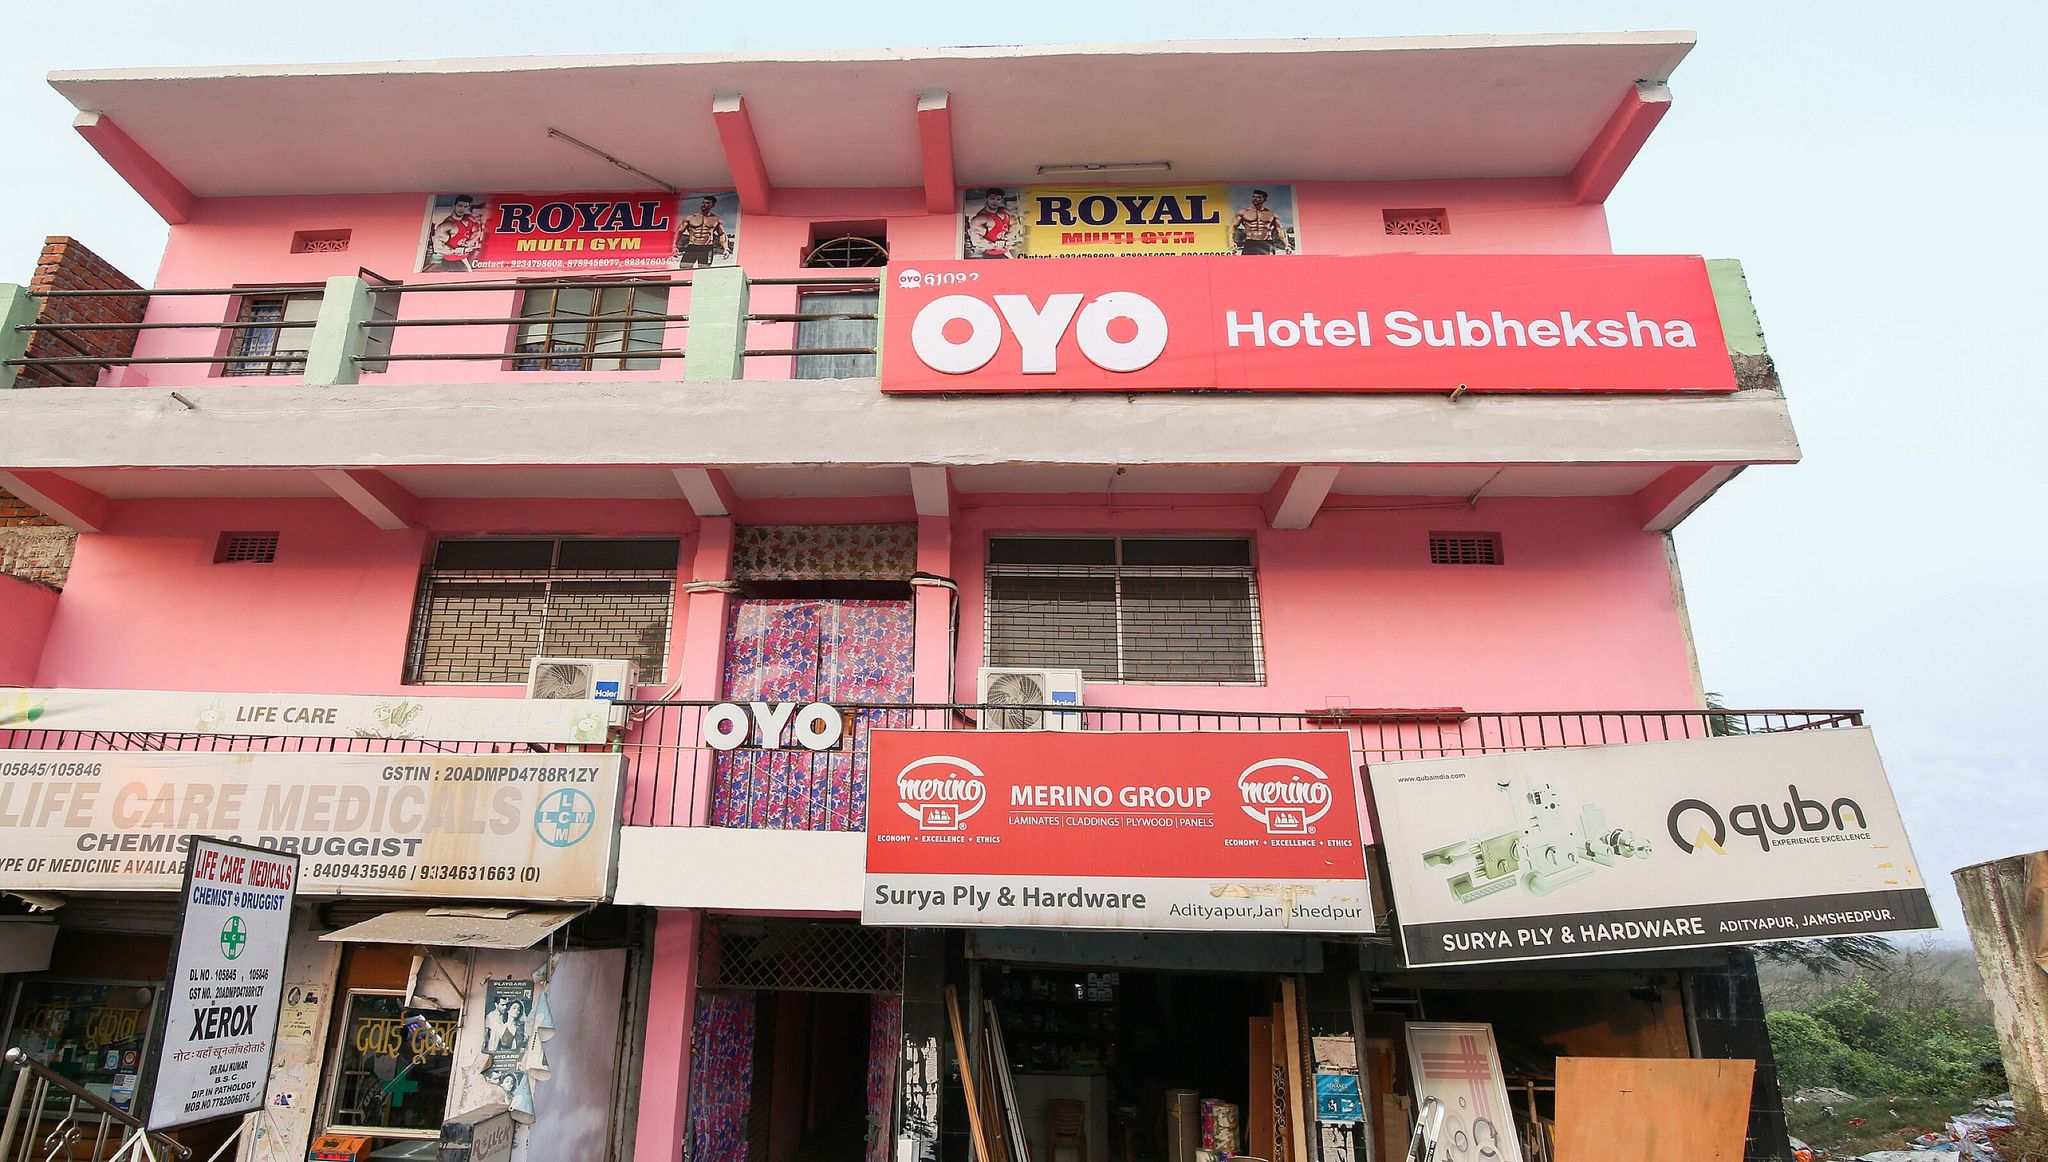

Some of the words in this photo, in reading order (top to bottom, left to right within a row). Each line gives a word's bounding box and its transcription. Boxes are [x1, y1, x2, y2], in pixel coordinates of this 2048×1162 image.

[495, 200, 669, 234] ROYAL
[1035, 195, 1221, 227] ROYAL
[516, 238, 584, 252] MULTI
[590, 237, 642, 251] GYM
[471, 259, 504, 269] Contact
[624, 257, 677, 267] 923476056
[911, 290, 1169, 375] OYO
[1226, 308, 1369, 348] Hotel
[1384, 308, 1697, 351] Subheksha
[595, 689, 618, 698] Haier
[236, 705, 279, 723] LIFE
[282, 706, 338, 724] CARE
[702, 702, 843, 750] OYO
[382, 766, 431, 781] GSTIN
[444, 766, 600, 783] 20ADMPD4788R1ZY
[1397, 772, 1466, 783] www.qubaindia.com
[899, 773, 981, 801] merino
[1010, 785, 1114, 807] MERINO
[1118, 786, 1211, 808] GROUP
[1241, 775, 1327, 804] merino
[0, 782, 102, 828] LIFE
[112, 781, 249, 831] CARE
[257, 784, 523, 836] MEDICALS
[1008, 816, 1059, 826] LAMINATES
[1066, 816, 1119, 827] CLADDINGS
[1126, 817, 1173, 827] PLYWOOD
[1179, 818, 1214, 828] PANELS
[77, 833, 216, 852] CHEMIS
[258, 836, 422, 857] DRUGGIST
[921, 835, 965, 843] EXCELLENCE
[1271, 839, 1316, 847] EXCELLENCE
[1772, 836, 1820, 847] EXPERIENCE
[1821, 832, 1871, 844] EXCELLENCE
[27, 858, 46, 872] OF
[48, 858, 121, 874] MEDICINE
[313, 864, 406, 879] 8409435946
[195, 849, 219, 881] LIFE
[220, 855, 246, 885] CARE
[248, 859, 292, 891] MEDICALS
[193, 886, 233, 907] CHEMIST
[241, 892, 285, 911] DRUGGIST
[876, 884, 945, 910] Surya
[953, 885, 990, 911] Ply
[997, 886, 1016, 907] &
[1022, 886, 1147, 909] Hardware
[1443, 931, 1513, 953] SURYA
[1518, 927, 1553, 947] PLY
[1561, 925, 1576, 944] &
[1581, 917, 1706, 943] HARDWARE
[1719, 915, 1799, 933] ADITYAPUR,
[1801, 908, 1896, 928] JAMSHEDPUR.
[189, 969, 198, 981] DL
[215, 968, 237, 981] 105845
[189, 987, 201, 1000] GST
[188, 1004, 258, 1041] XEROX
[229, 1060, 249, 1072] KUMAR
[214, 1081, 257, 1095] PATHOLOGY
